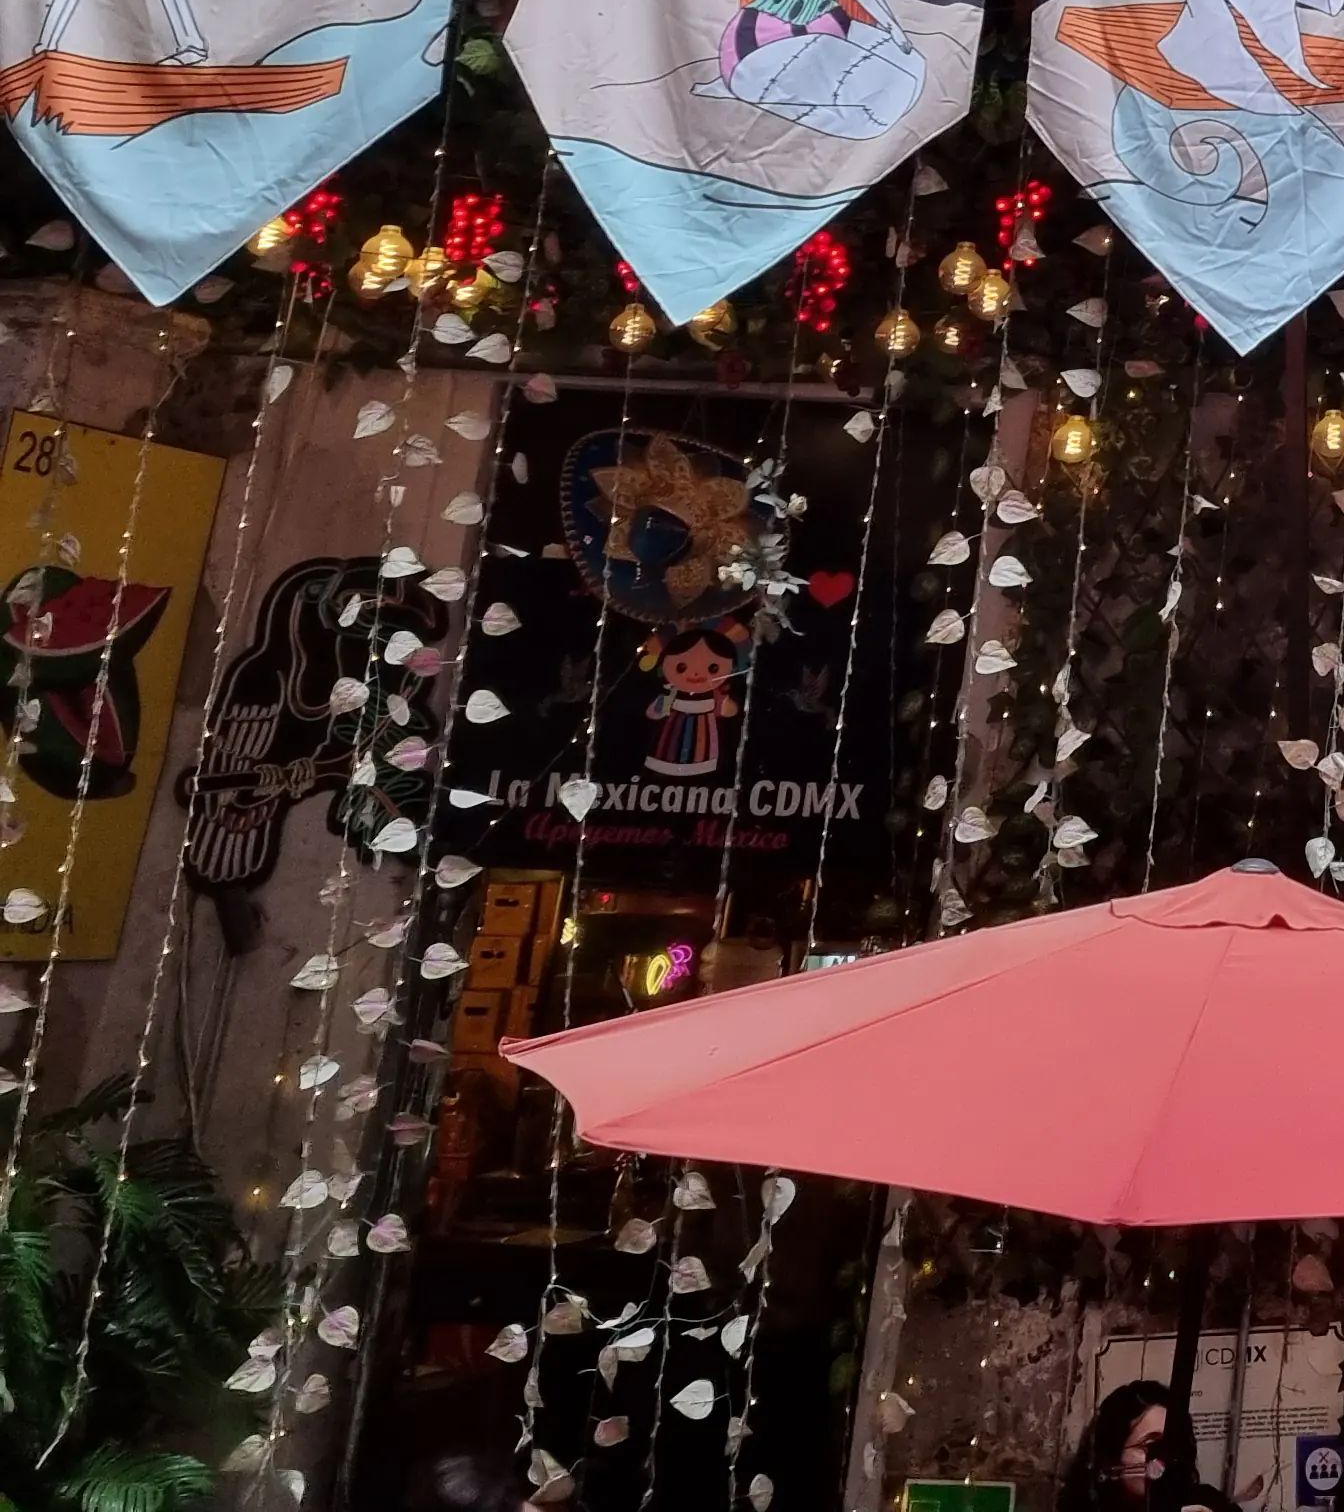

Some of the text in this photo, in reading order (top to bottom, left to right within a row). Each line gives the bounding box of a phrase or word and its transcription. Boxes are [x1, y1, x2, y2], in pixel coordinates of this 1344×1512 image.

[13, 430, 55, 476] 28
[488, 769, 865, 820] La Mexicana CDMX
